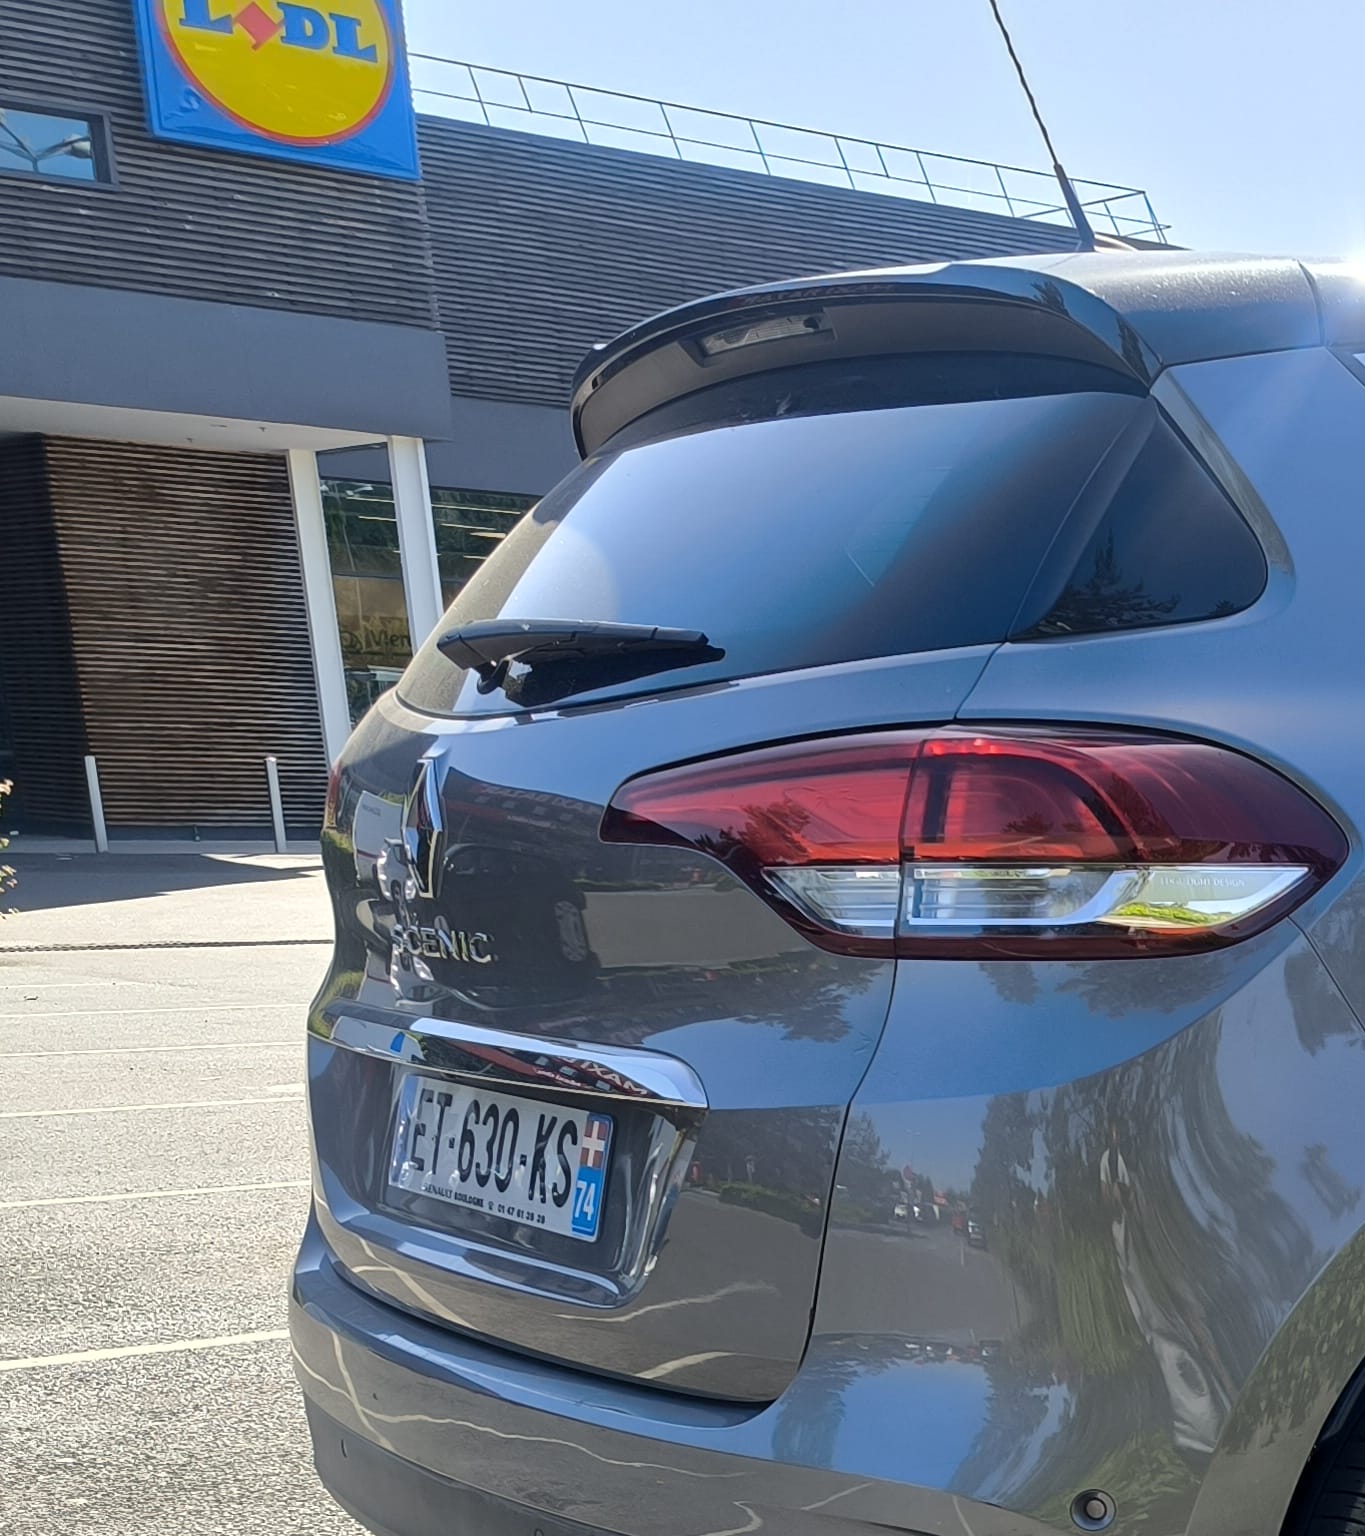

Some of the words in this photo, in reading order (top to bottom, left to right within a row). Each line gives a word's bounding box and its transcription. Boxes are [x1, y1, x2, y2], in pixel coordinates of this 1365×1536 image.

[179, 0, 378, 63] LIDL
[390, 923, 491, 964] SCENIC
[410, 1087, 579, 1208] ET-630-KS
[574, 1180, 597, 1222] 74
